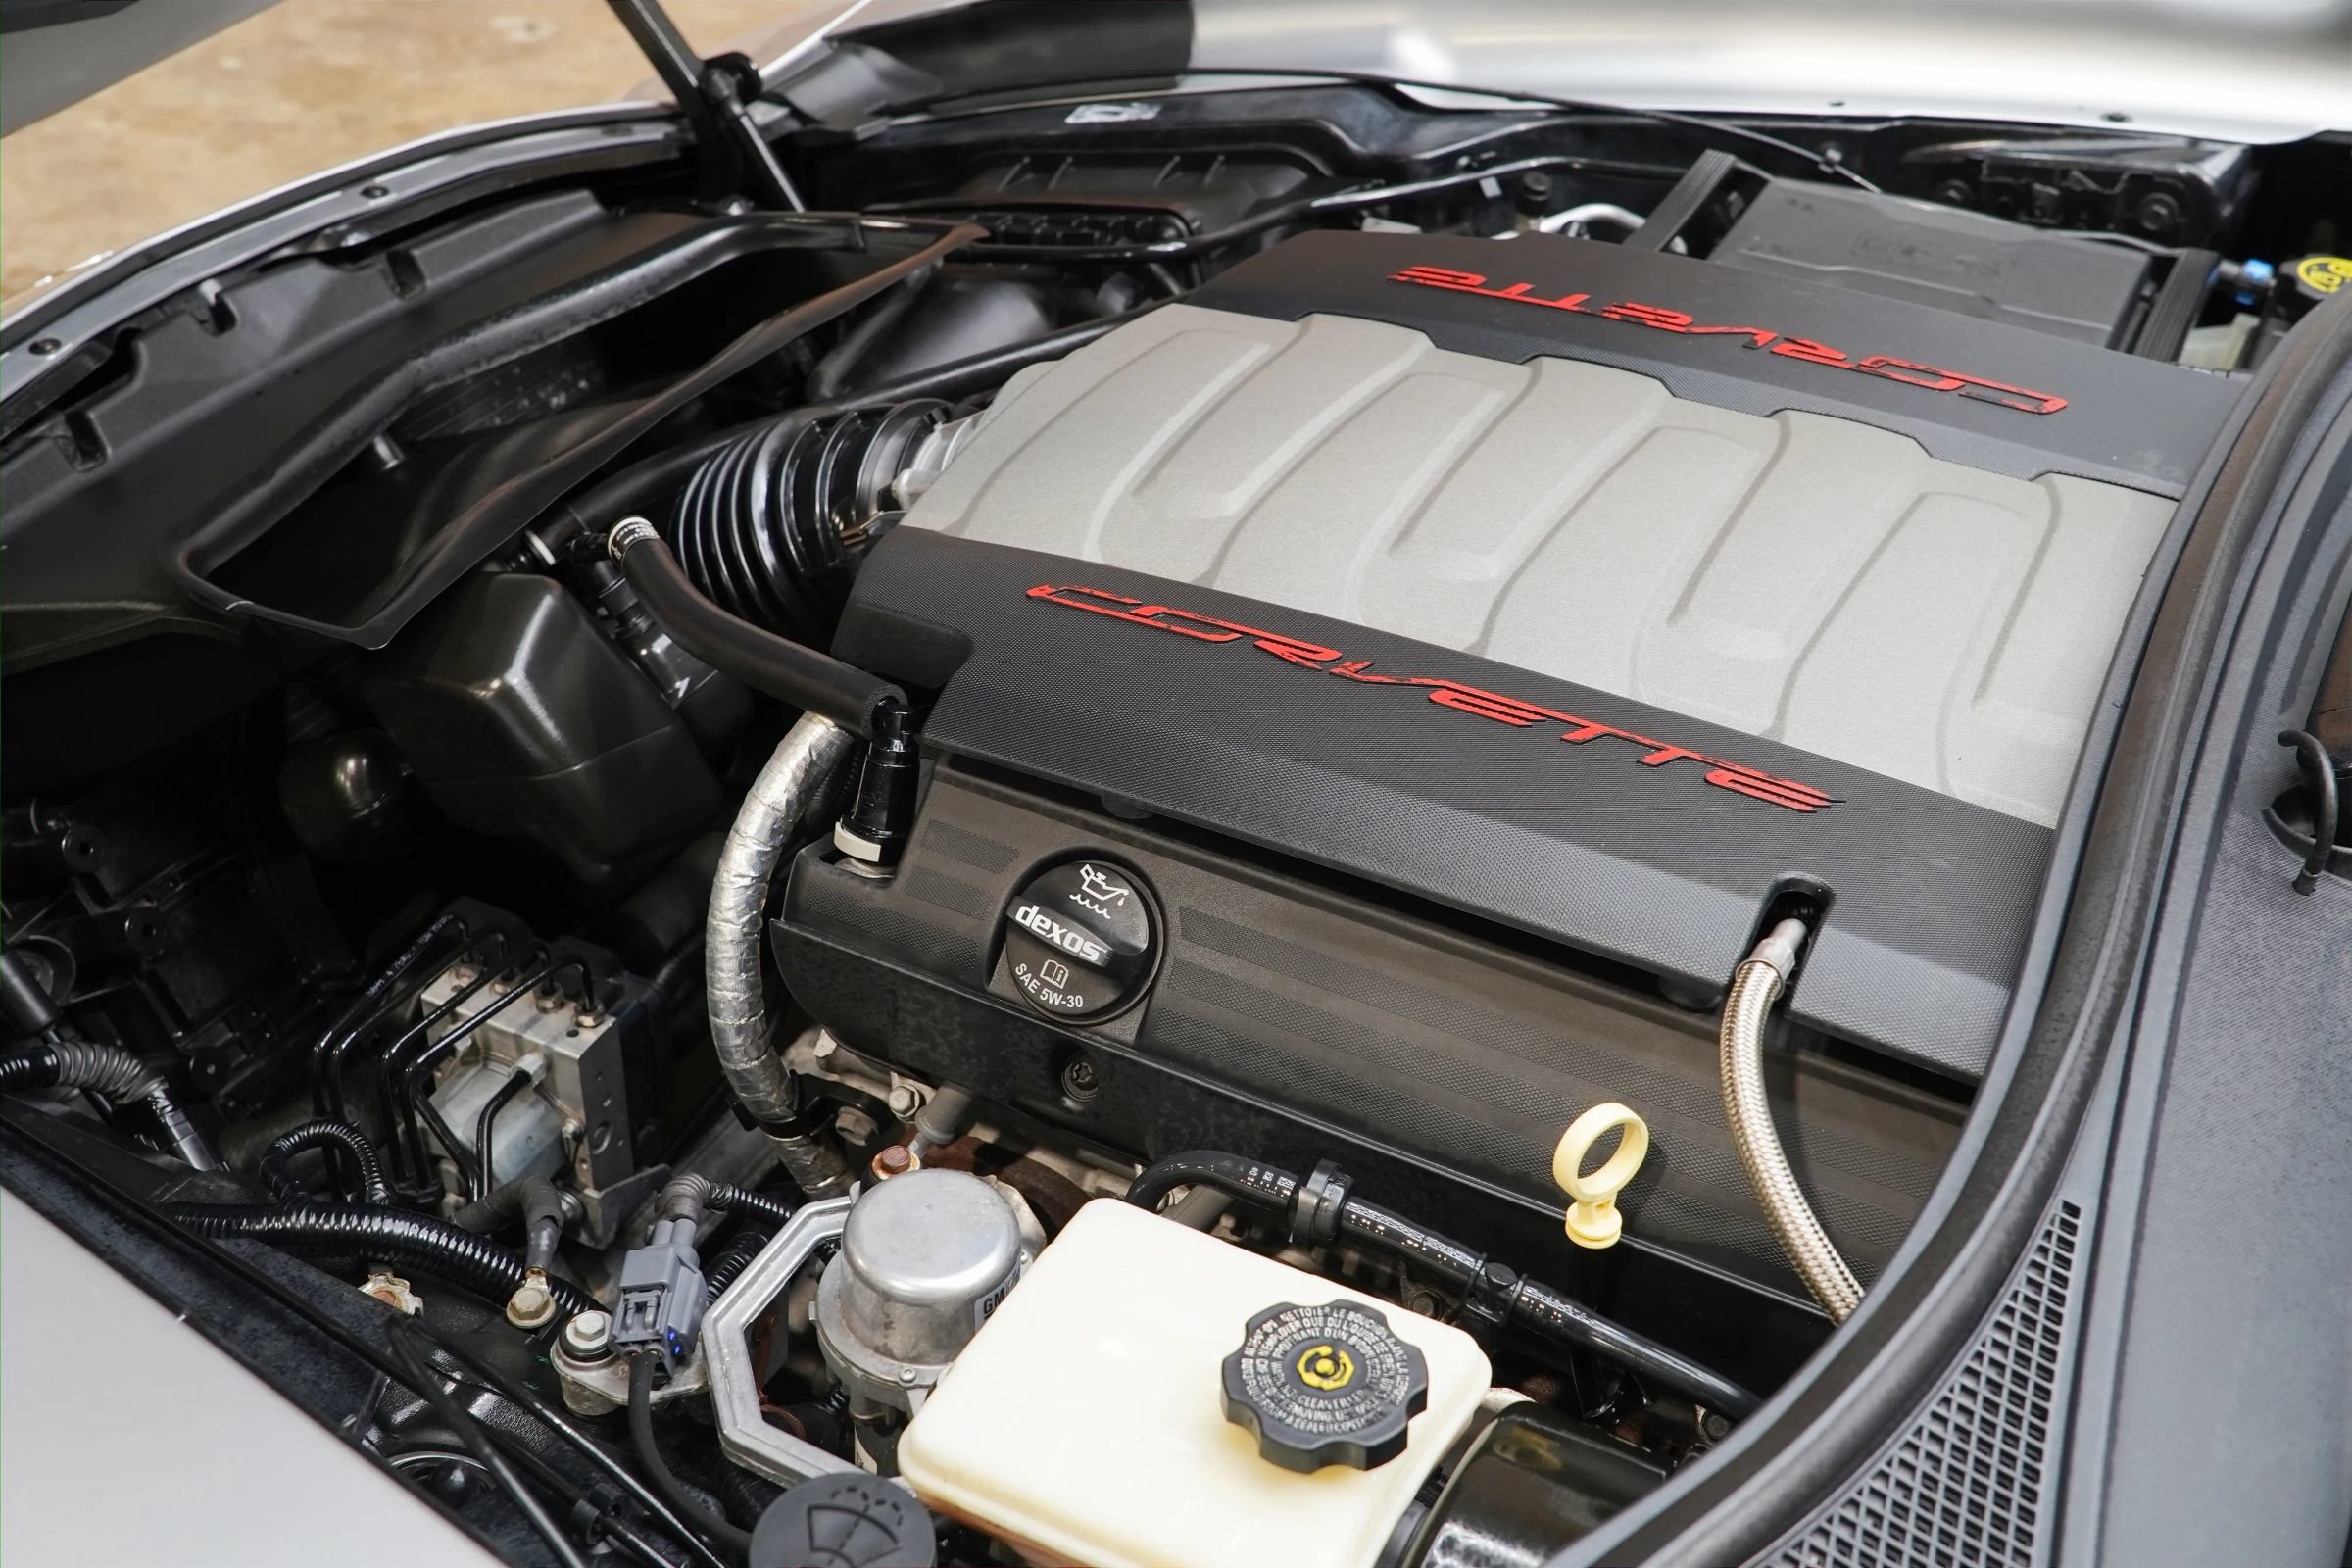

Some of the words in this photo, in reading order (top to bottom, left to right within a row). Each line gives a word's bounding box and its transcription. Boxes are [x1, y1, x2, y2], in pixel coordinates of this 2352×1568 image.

[1387, 266, 2068, 415] CORVETTE
[1025, 584, 1846, 813] CORVETTE
[1014, 905, 1101, 962] dexos
[1015, 963, 1040, 994] SAE
[1039, 988, 1084, 1008] 5W-30
[983, 1287, 1004, 1314] GM
[1302, 1316, 1325, 1328] QUE
[1327, 1316, 1341, 1328] DU
[1373, 1342, 1389, 1354] DE
[1333, 1308, 1347, 1319] LE
[1347, 1311, 1388, 1339] BOUCHON
[1298, 1395, 1332, 1410] CLEAN
